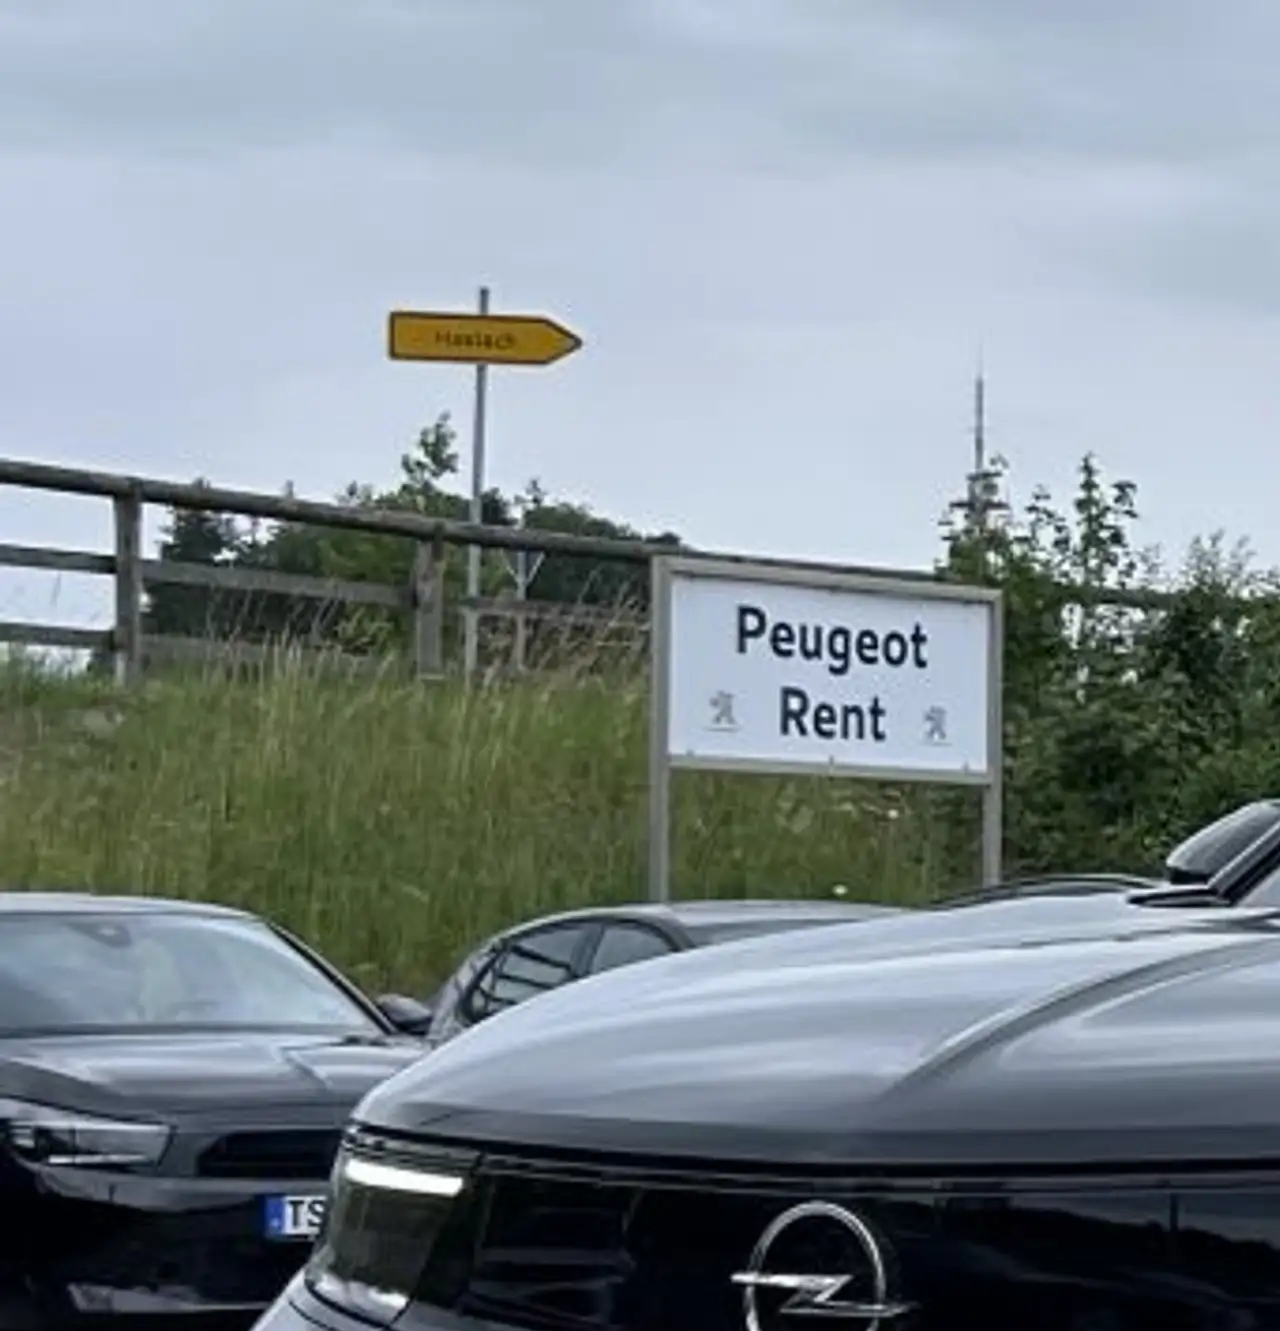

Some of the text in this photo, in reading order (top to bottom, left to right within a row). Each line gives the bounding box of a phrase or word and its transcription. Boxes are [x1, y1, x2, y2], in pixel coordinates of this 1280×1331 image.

[737, 604, 928, 676] Peugeot
[779, 685, 887, 742] Rent
[289, 1200, 327, 1228] TS
